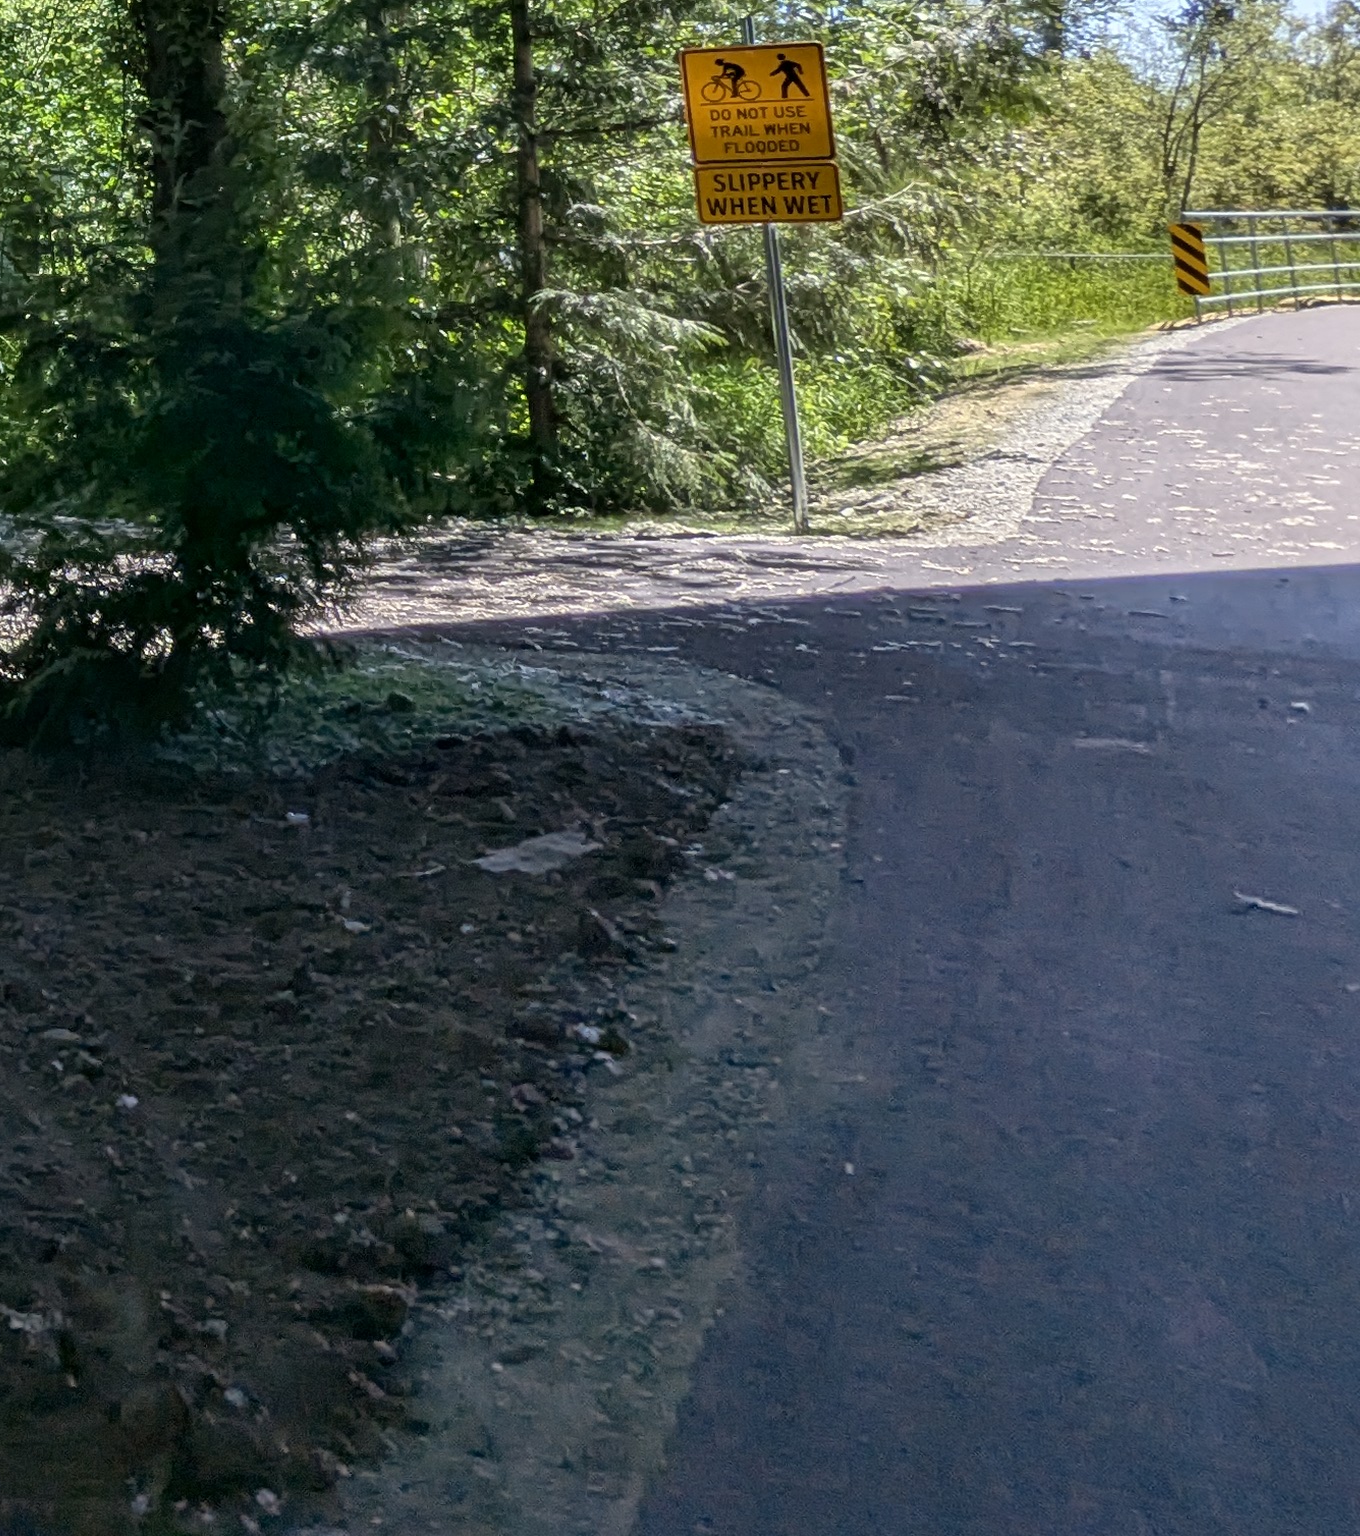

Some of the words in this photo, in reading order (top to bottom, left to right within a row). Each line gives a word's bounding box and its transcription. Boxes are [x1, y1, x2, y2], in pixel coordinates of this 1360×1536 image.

[710, 109, 731, 121] DO
[737, 107, 767, 120] NOT
[773, 106, 807, 118] USE
[710, 125, 760, 138] TRAIL
[764, 122, 811, 135] WHEN
[724, 140, 800, 154] FLOODED
[713, 171, 821, 193] SLIPPERY
[706, 195, 777, 216] WHEN
[783, 194, 832, 215] WET
